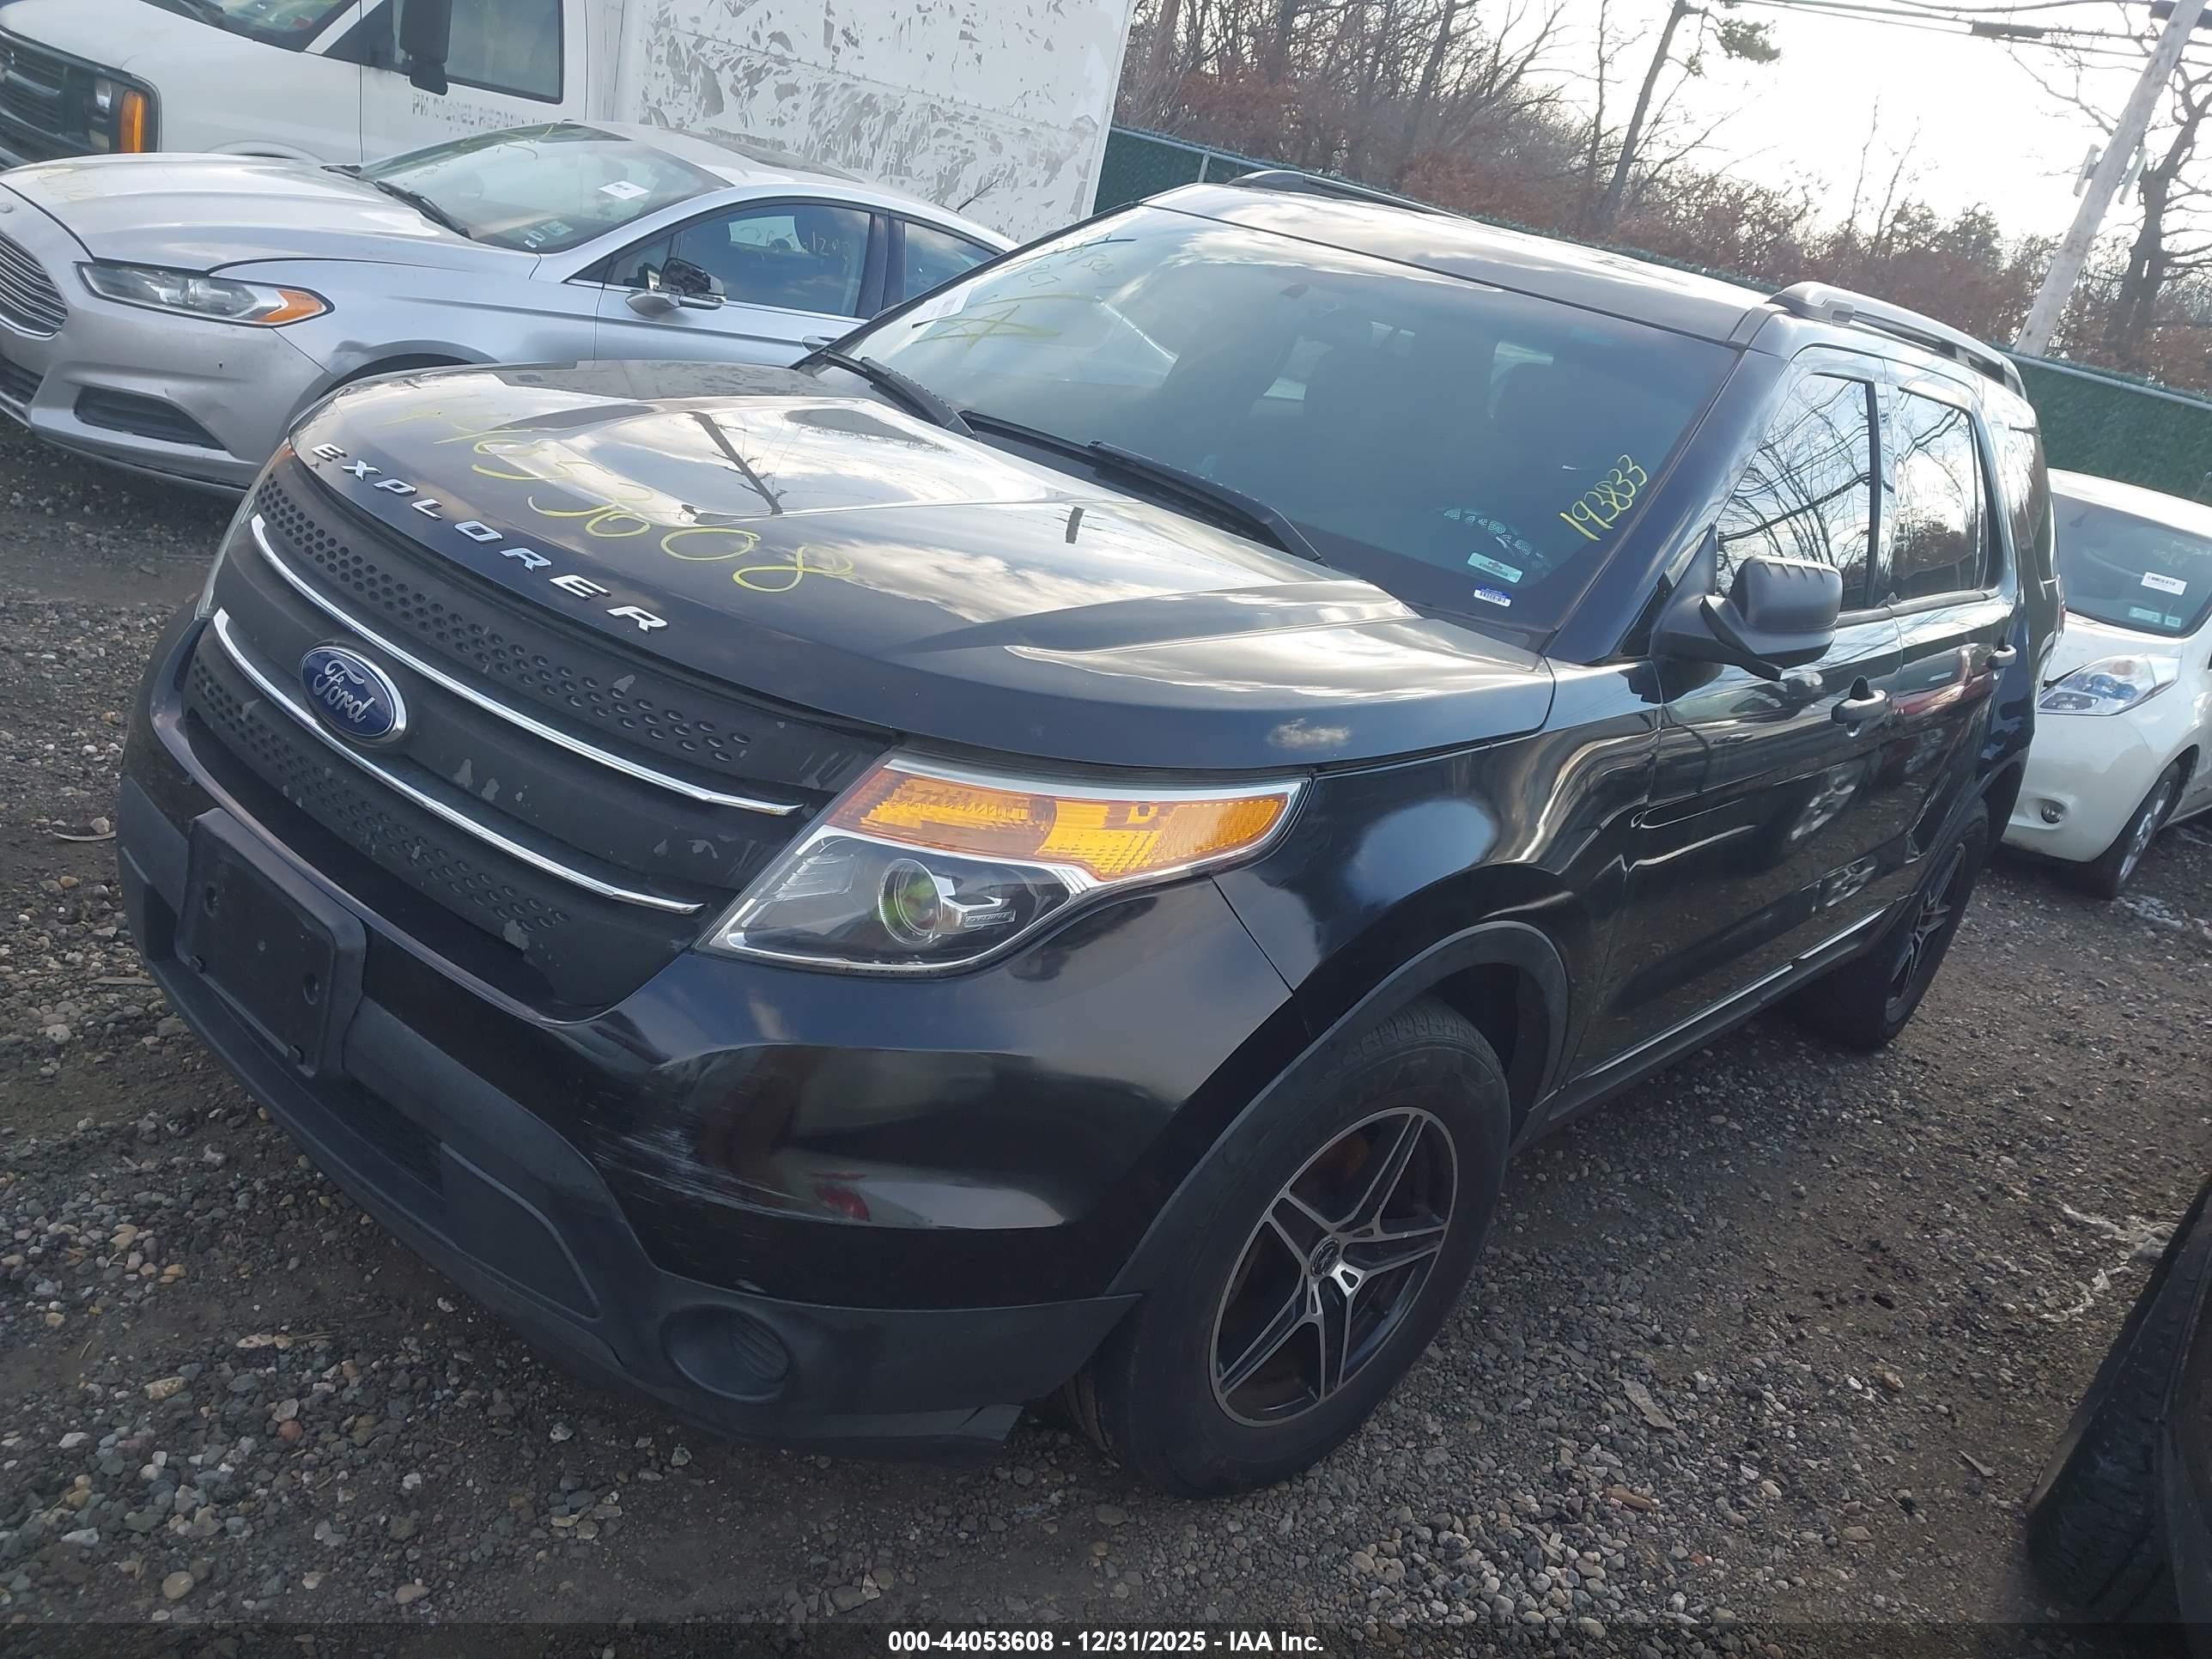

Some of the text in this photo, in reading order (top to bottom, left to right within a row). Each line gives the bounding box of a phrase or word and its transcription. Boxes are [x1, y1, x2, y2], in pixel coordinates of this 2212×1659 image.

[311, 442, 670, 634] EXPLORER
[1559, 453, 1648, 541] 193833
[313, 659, 376, 723] Ford
